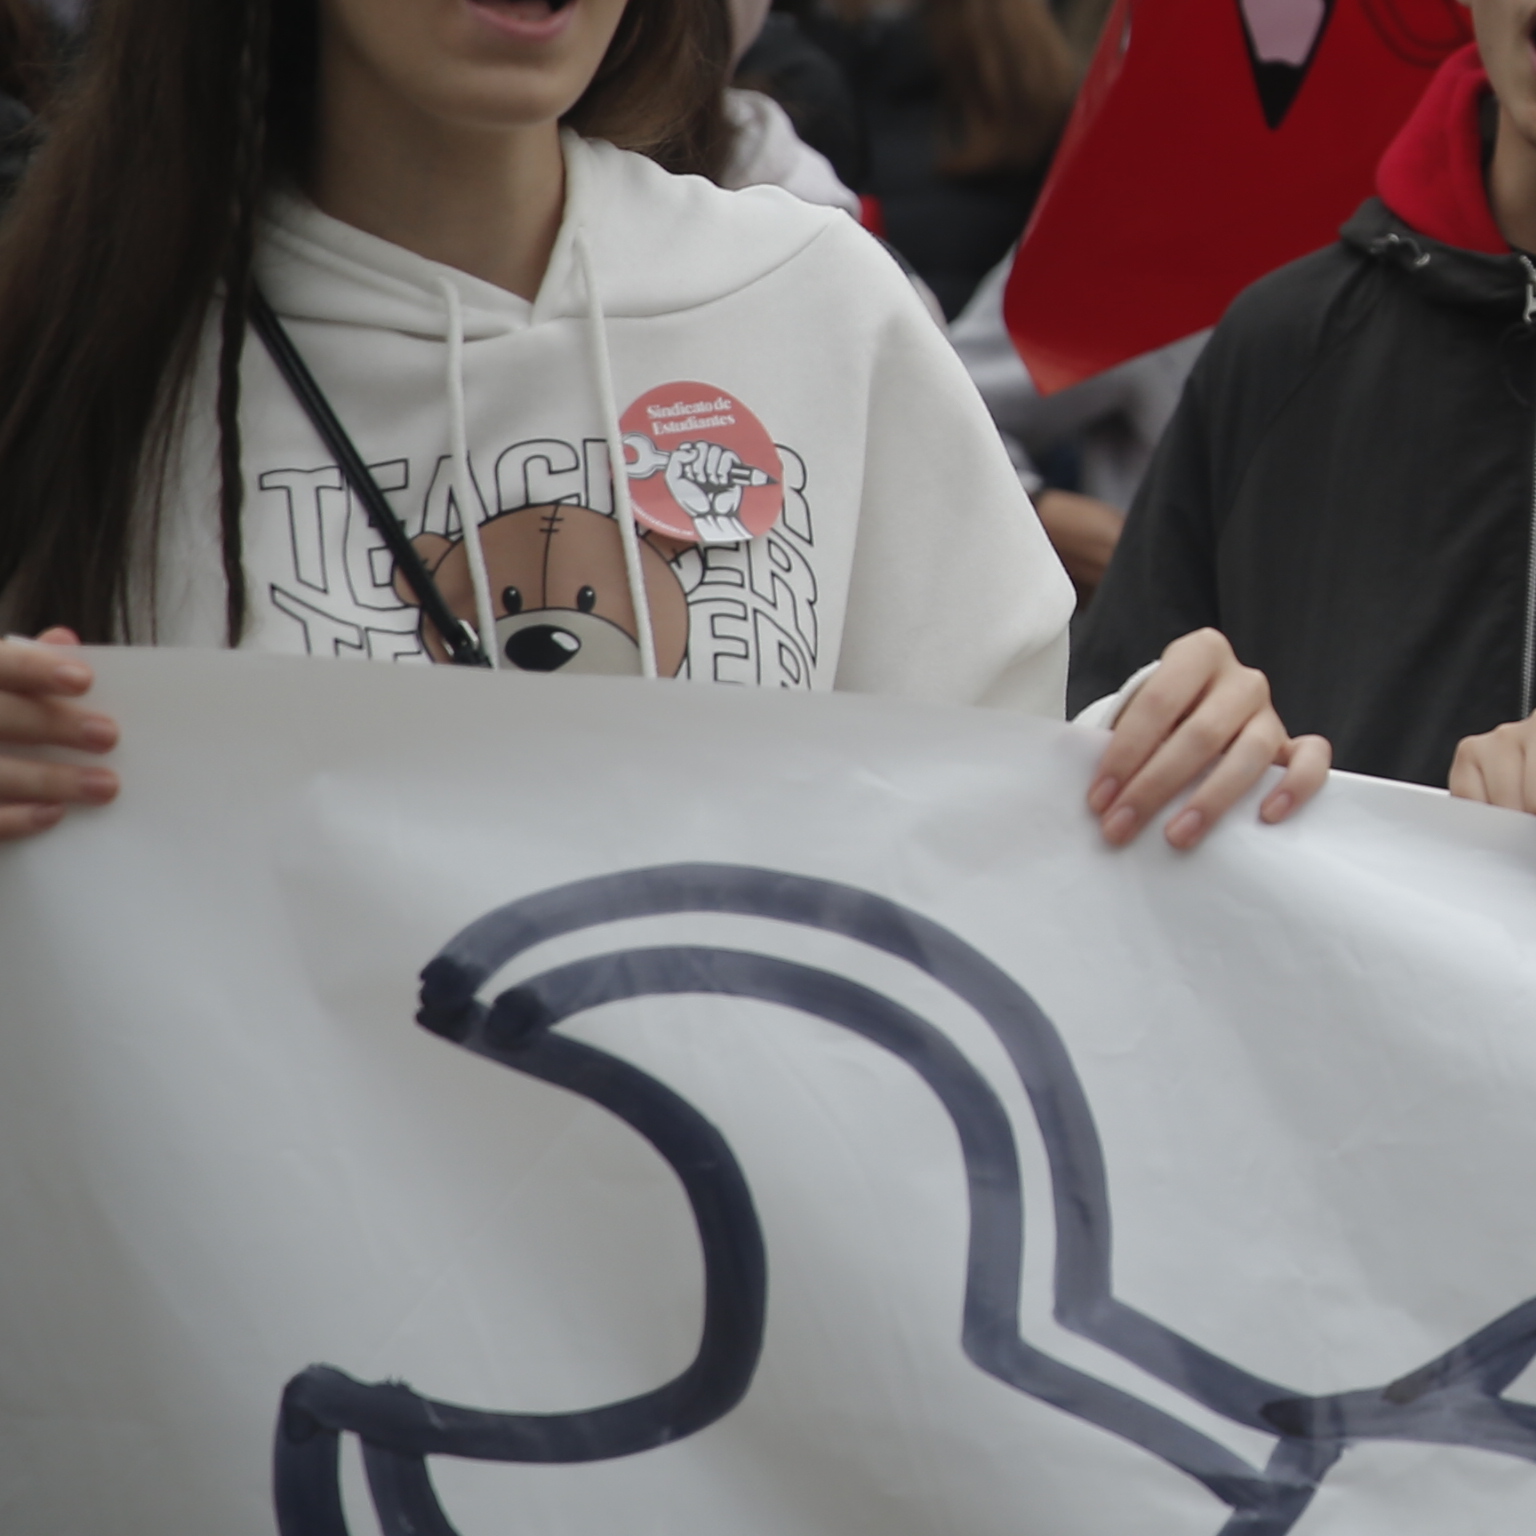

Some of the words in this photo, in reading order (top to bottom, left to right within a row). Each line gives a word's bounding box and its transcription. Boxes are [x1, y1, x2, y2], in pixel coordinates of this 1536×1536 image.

[647, 400, 712, 419] Sindicato
[713, 397, 732, 412] de
[652, 414, 735, 435] Estudiantes
